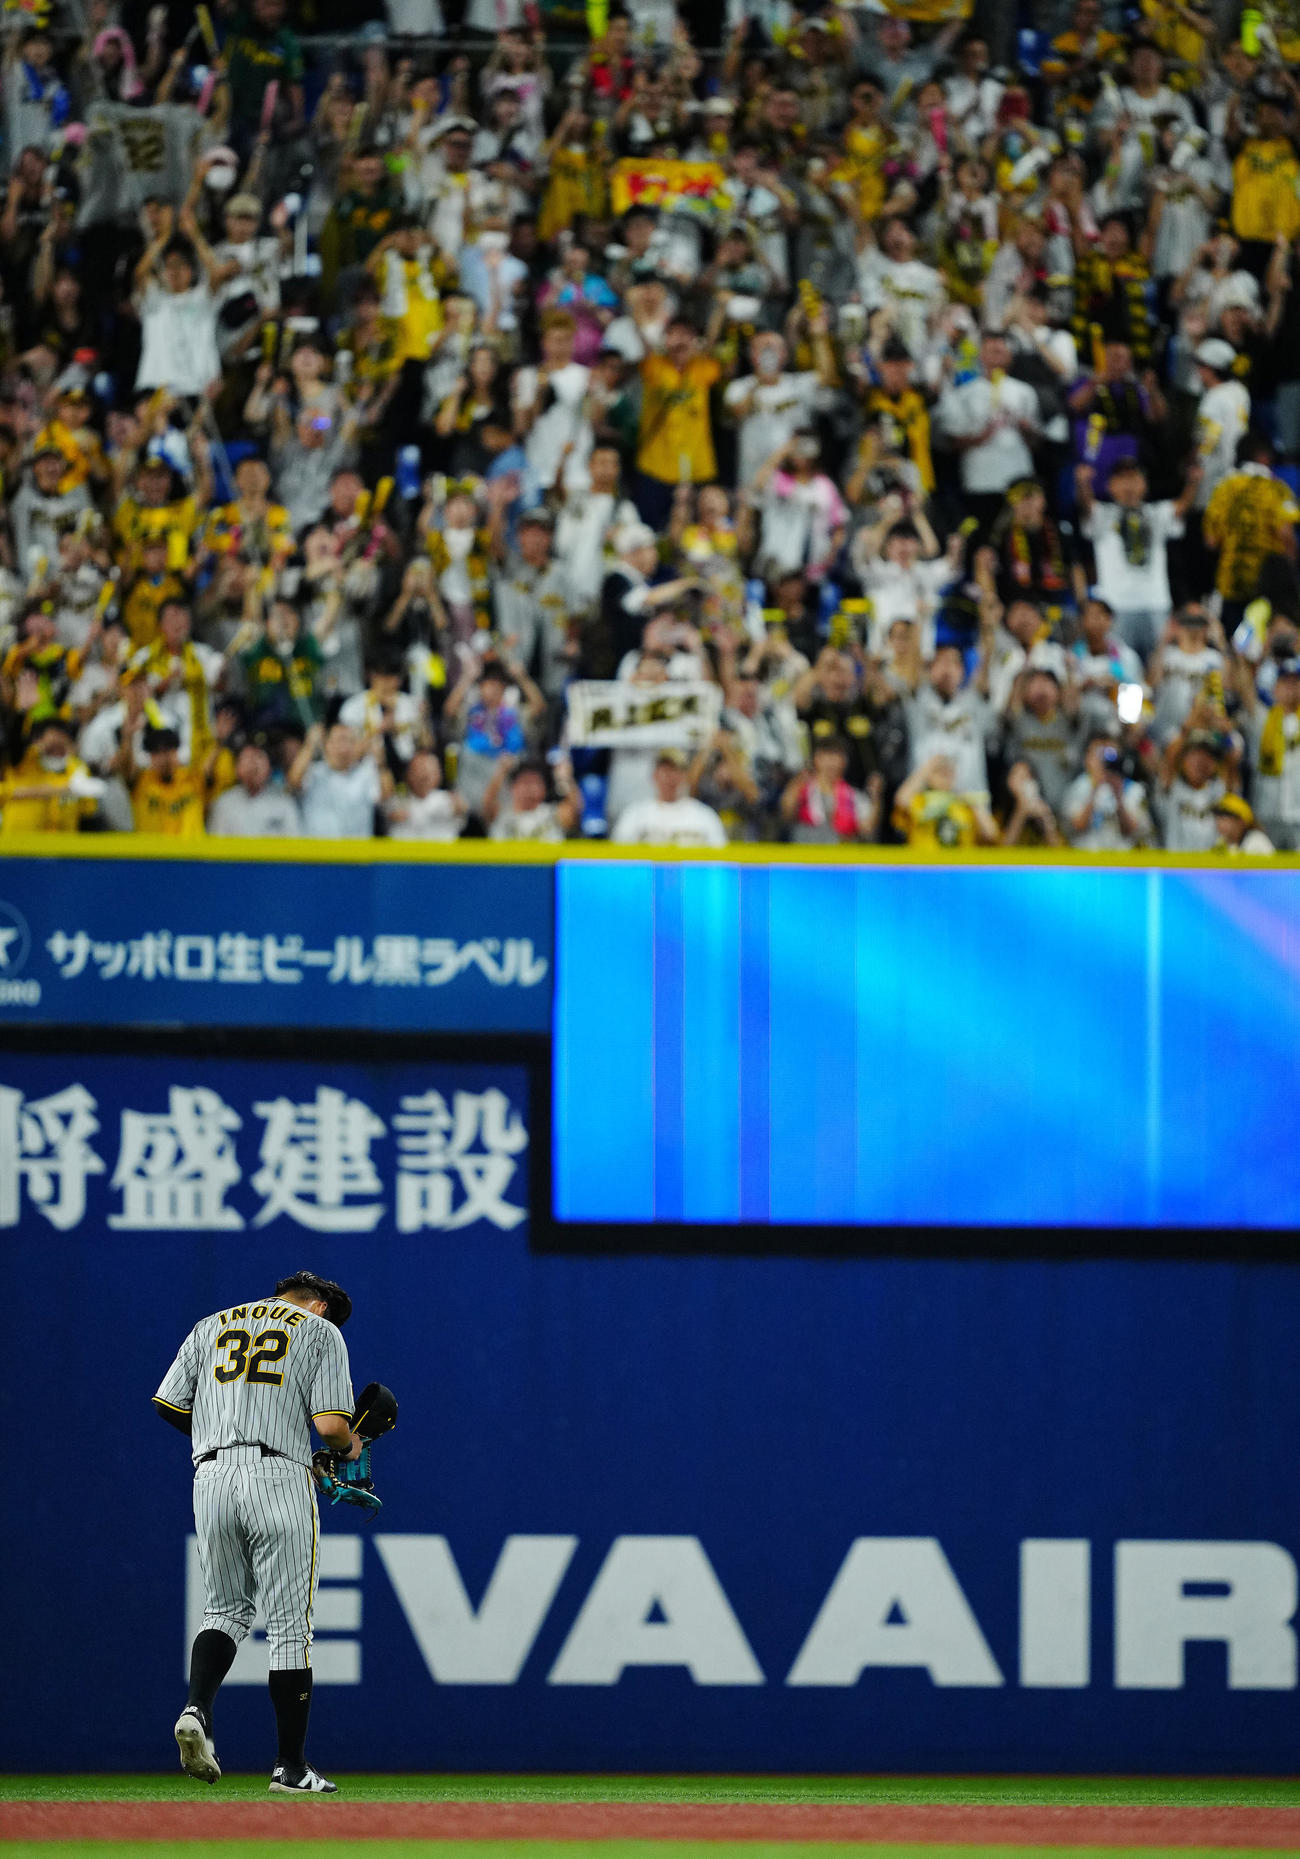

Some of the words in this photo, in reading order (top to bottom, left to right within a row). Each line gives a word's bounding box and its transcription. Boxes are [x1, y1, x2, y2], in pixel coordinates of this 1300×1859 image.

[46, 929, 547, 986] サッポロ生ビール黒ラベル
[218, 1304, 308, 1328] INOUE
[214, 1328, 290, 1387] 32
[786, 1536, 1298, 1690] AIR
